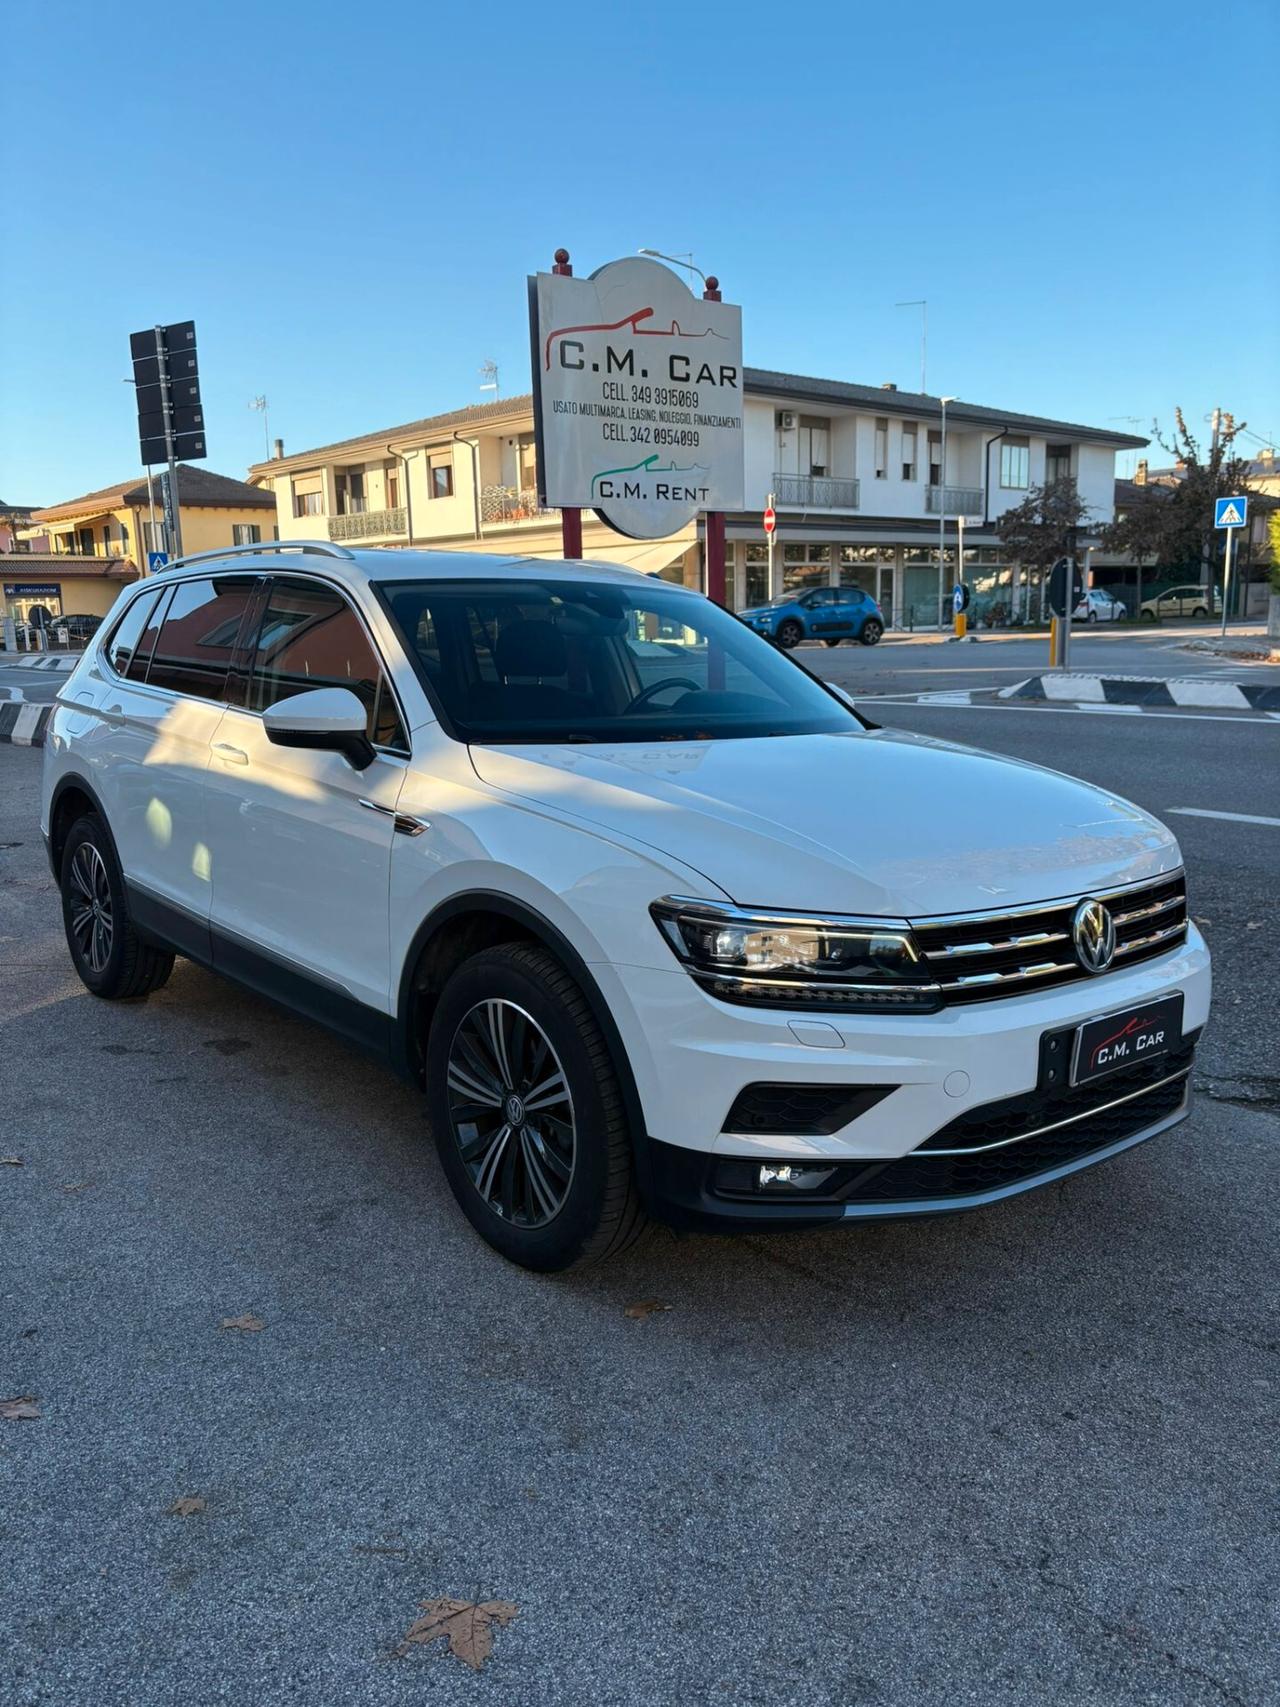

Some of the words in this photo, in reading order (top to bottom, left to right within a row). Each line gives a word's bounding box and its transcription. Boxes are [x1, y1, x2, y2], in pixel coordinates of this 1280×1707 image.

[560, 340, 648, 378] C.M.
[602, 381, 629, 402] CELL.
[631, 385, 651, 404] 349
[654, 387, 699, 409] 3915069
[552, 400, 578, 415] USATO
[693, 414, 742, 430] FINANZIAMENTI
[602, 422, 629, 442] CELL.
[630, 426, 651, 444] 342
[653, 428, 700, 447] 0954099
[600, 481, 647, 499] C.M.
[1097, 1041, 1130, 1064] C.M.
